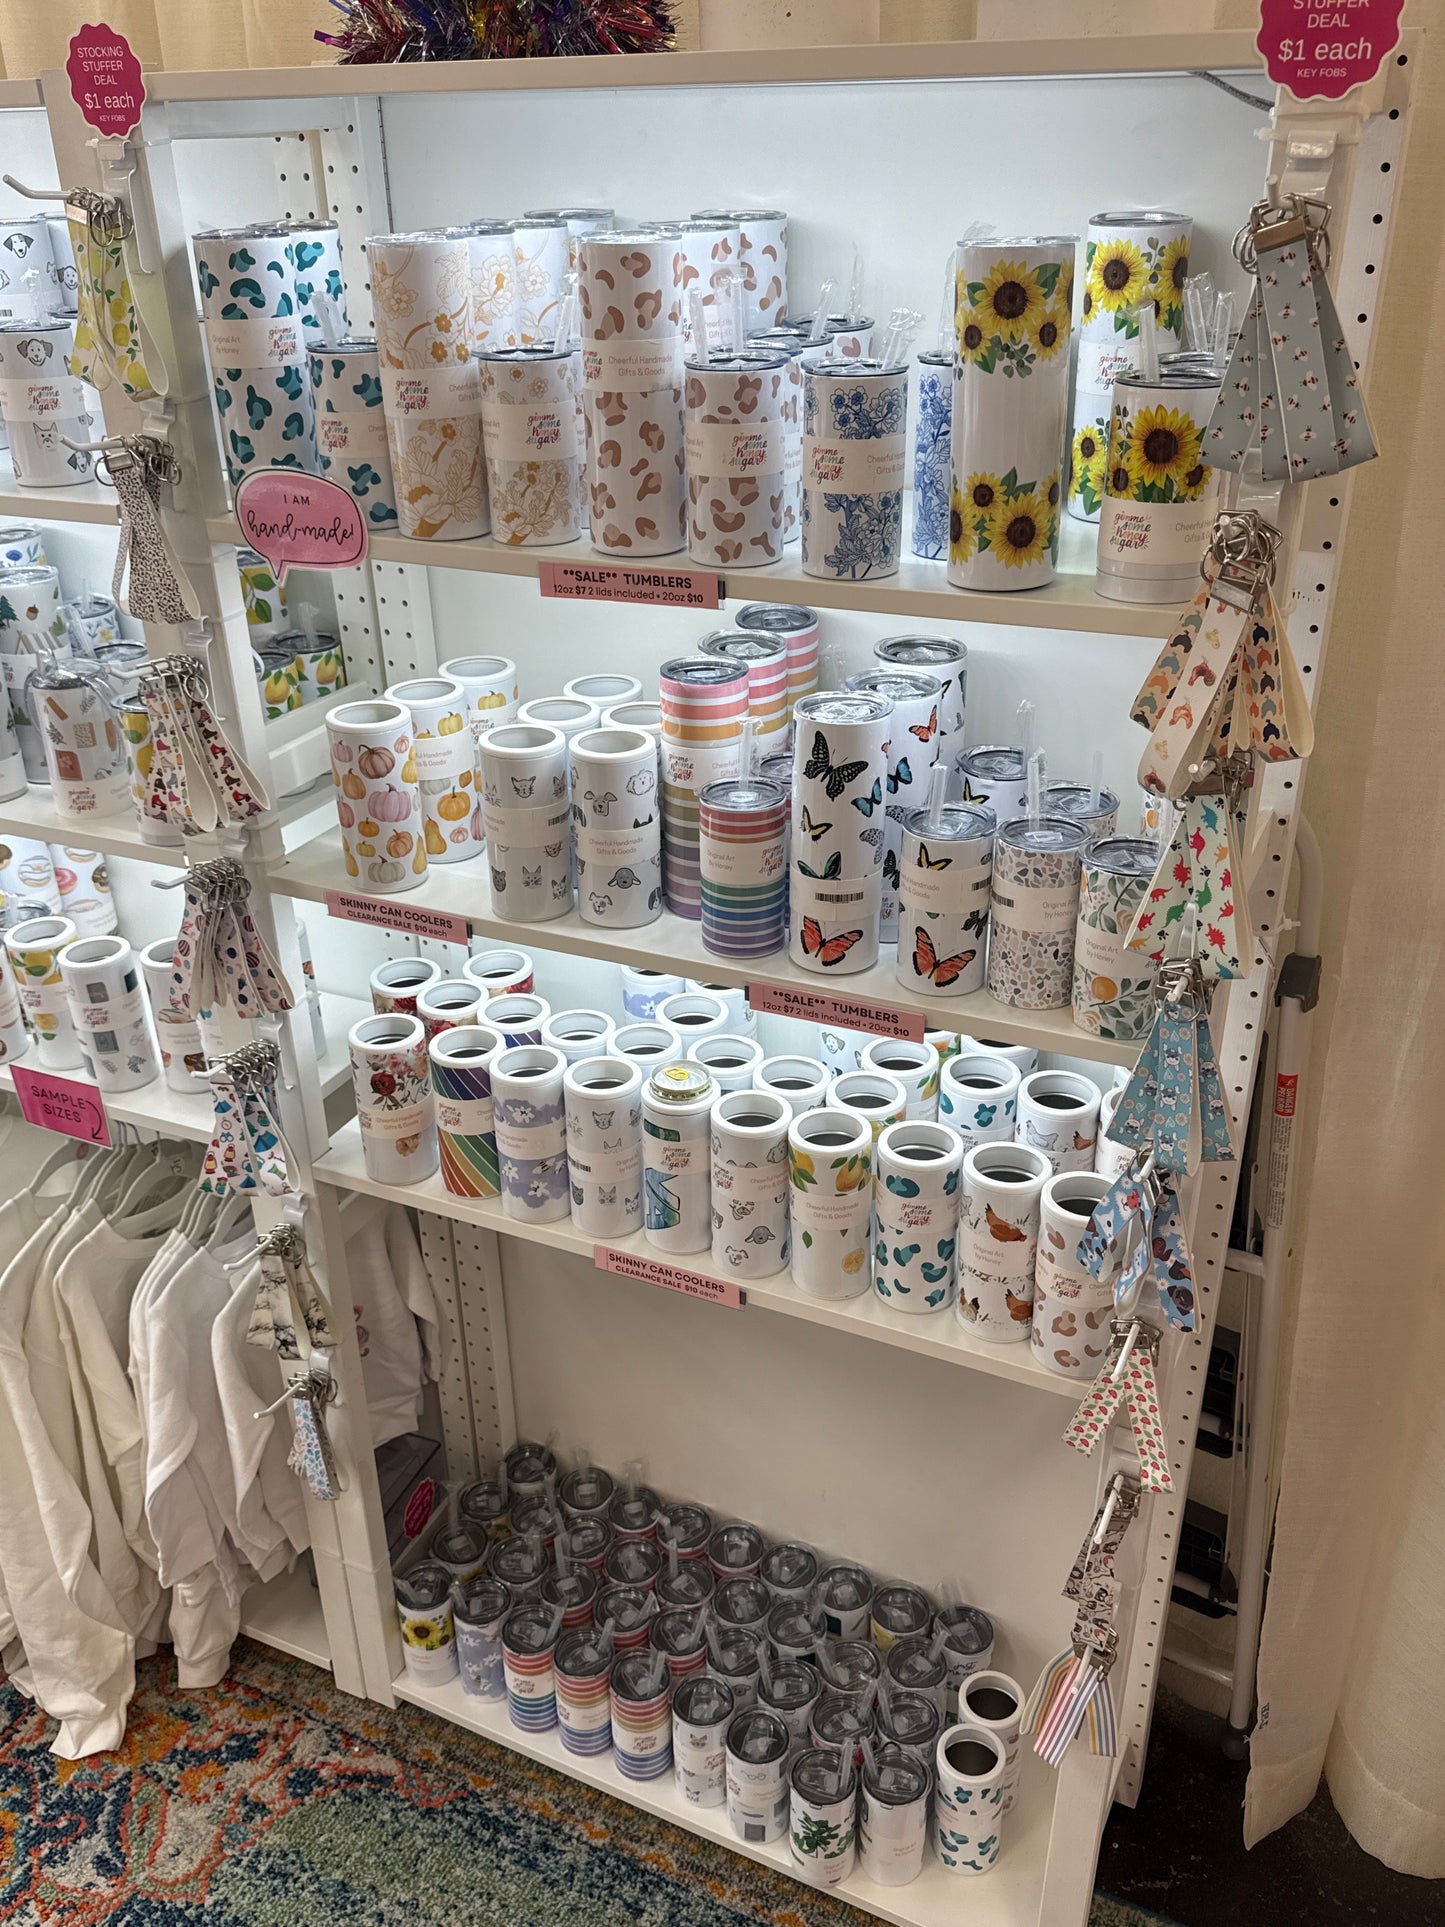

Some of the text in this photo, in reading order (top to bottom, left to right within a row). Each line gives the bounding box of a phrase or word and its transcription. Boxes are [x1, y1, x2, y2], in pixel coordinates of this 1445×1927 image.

[1307, 13, 1350, 28] DEAL
[77, 46, 124, 58] STOCKING
[1278, 36, 1372, 62] $1 each
[82, 60, 123, 72] STUFFER
[1296, 67, 1347, 77] KEY FOBS
[93, 74, 118, 86] DEAL
[84, 92, 135, 110] $1 each
[608, 356, 640, 365] Cheerful
[1107, 362, 1134, 371] some
[618, 367, 665, 377] Gifts & Goods
[395, 377, 422, 390] gimme
[404, 386, 429, 395] some
[528, 411, 555, 427] gimme
[537, 419, 561, 430] some
[532, 427, 560, 441] honey
[732, 433, 762, 447] gimme
[741, 439, 768, 450] some
[812, 444, 838, 459] gimme
[736, 447, 766, 463] honey
[819, 454, 845, 464] some
[728, 455, 765, 471] sugar
[814, 460, 842, 478] honey
[283, 494, 310, 506] I AM
[1114, 511, 1145, 524] gimme
[1116, 525, 1149, 544] honey
[1122, 522, 1151, 532] some
[1110, 536, 1147, 552] sugar
[623, 573, 692, 589] TUMBLERS
[553, 584, 704, 604] 12oz $7 2 lids included 20oz $10
[1042, 900, 1067, 910] Original
[340, 897, 453, 929] SKINNY CAN COOLERS
[1053, 910, 1073, 918] Honey
[347, 910, 448, 937] CLEARANCE SALE $10 each
[1085, 937, 1118, 954] Original Art
[1094, 952, 1115, 964] Honey
[763, 1001, 910, 1037] 12oz $7 2 lids included 20oz $10
[831, 1002, 899, 1024] TUMBLERS
[31, 1085, 86, 1110] SAMPLE
[43, 1103, 82, 1123] SIZES
[609, 1253, 725, 1293] SKINNY CAN COOLERS
[615, 1265, 719, 1300] CLEARANCE SALE $10 each
